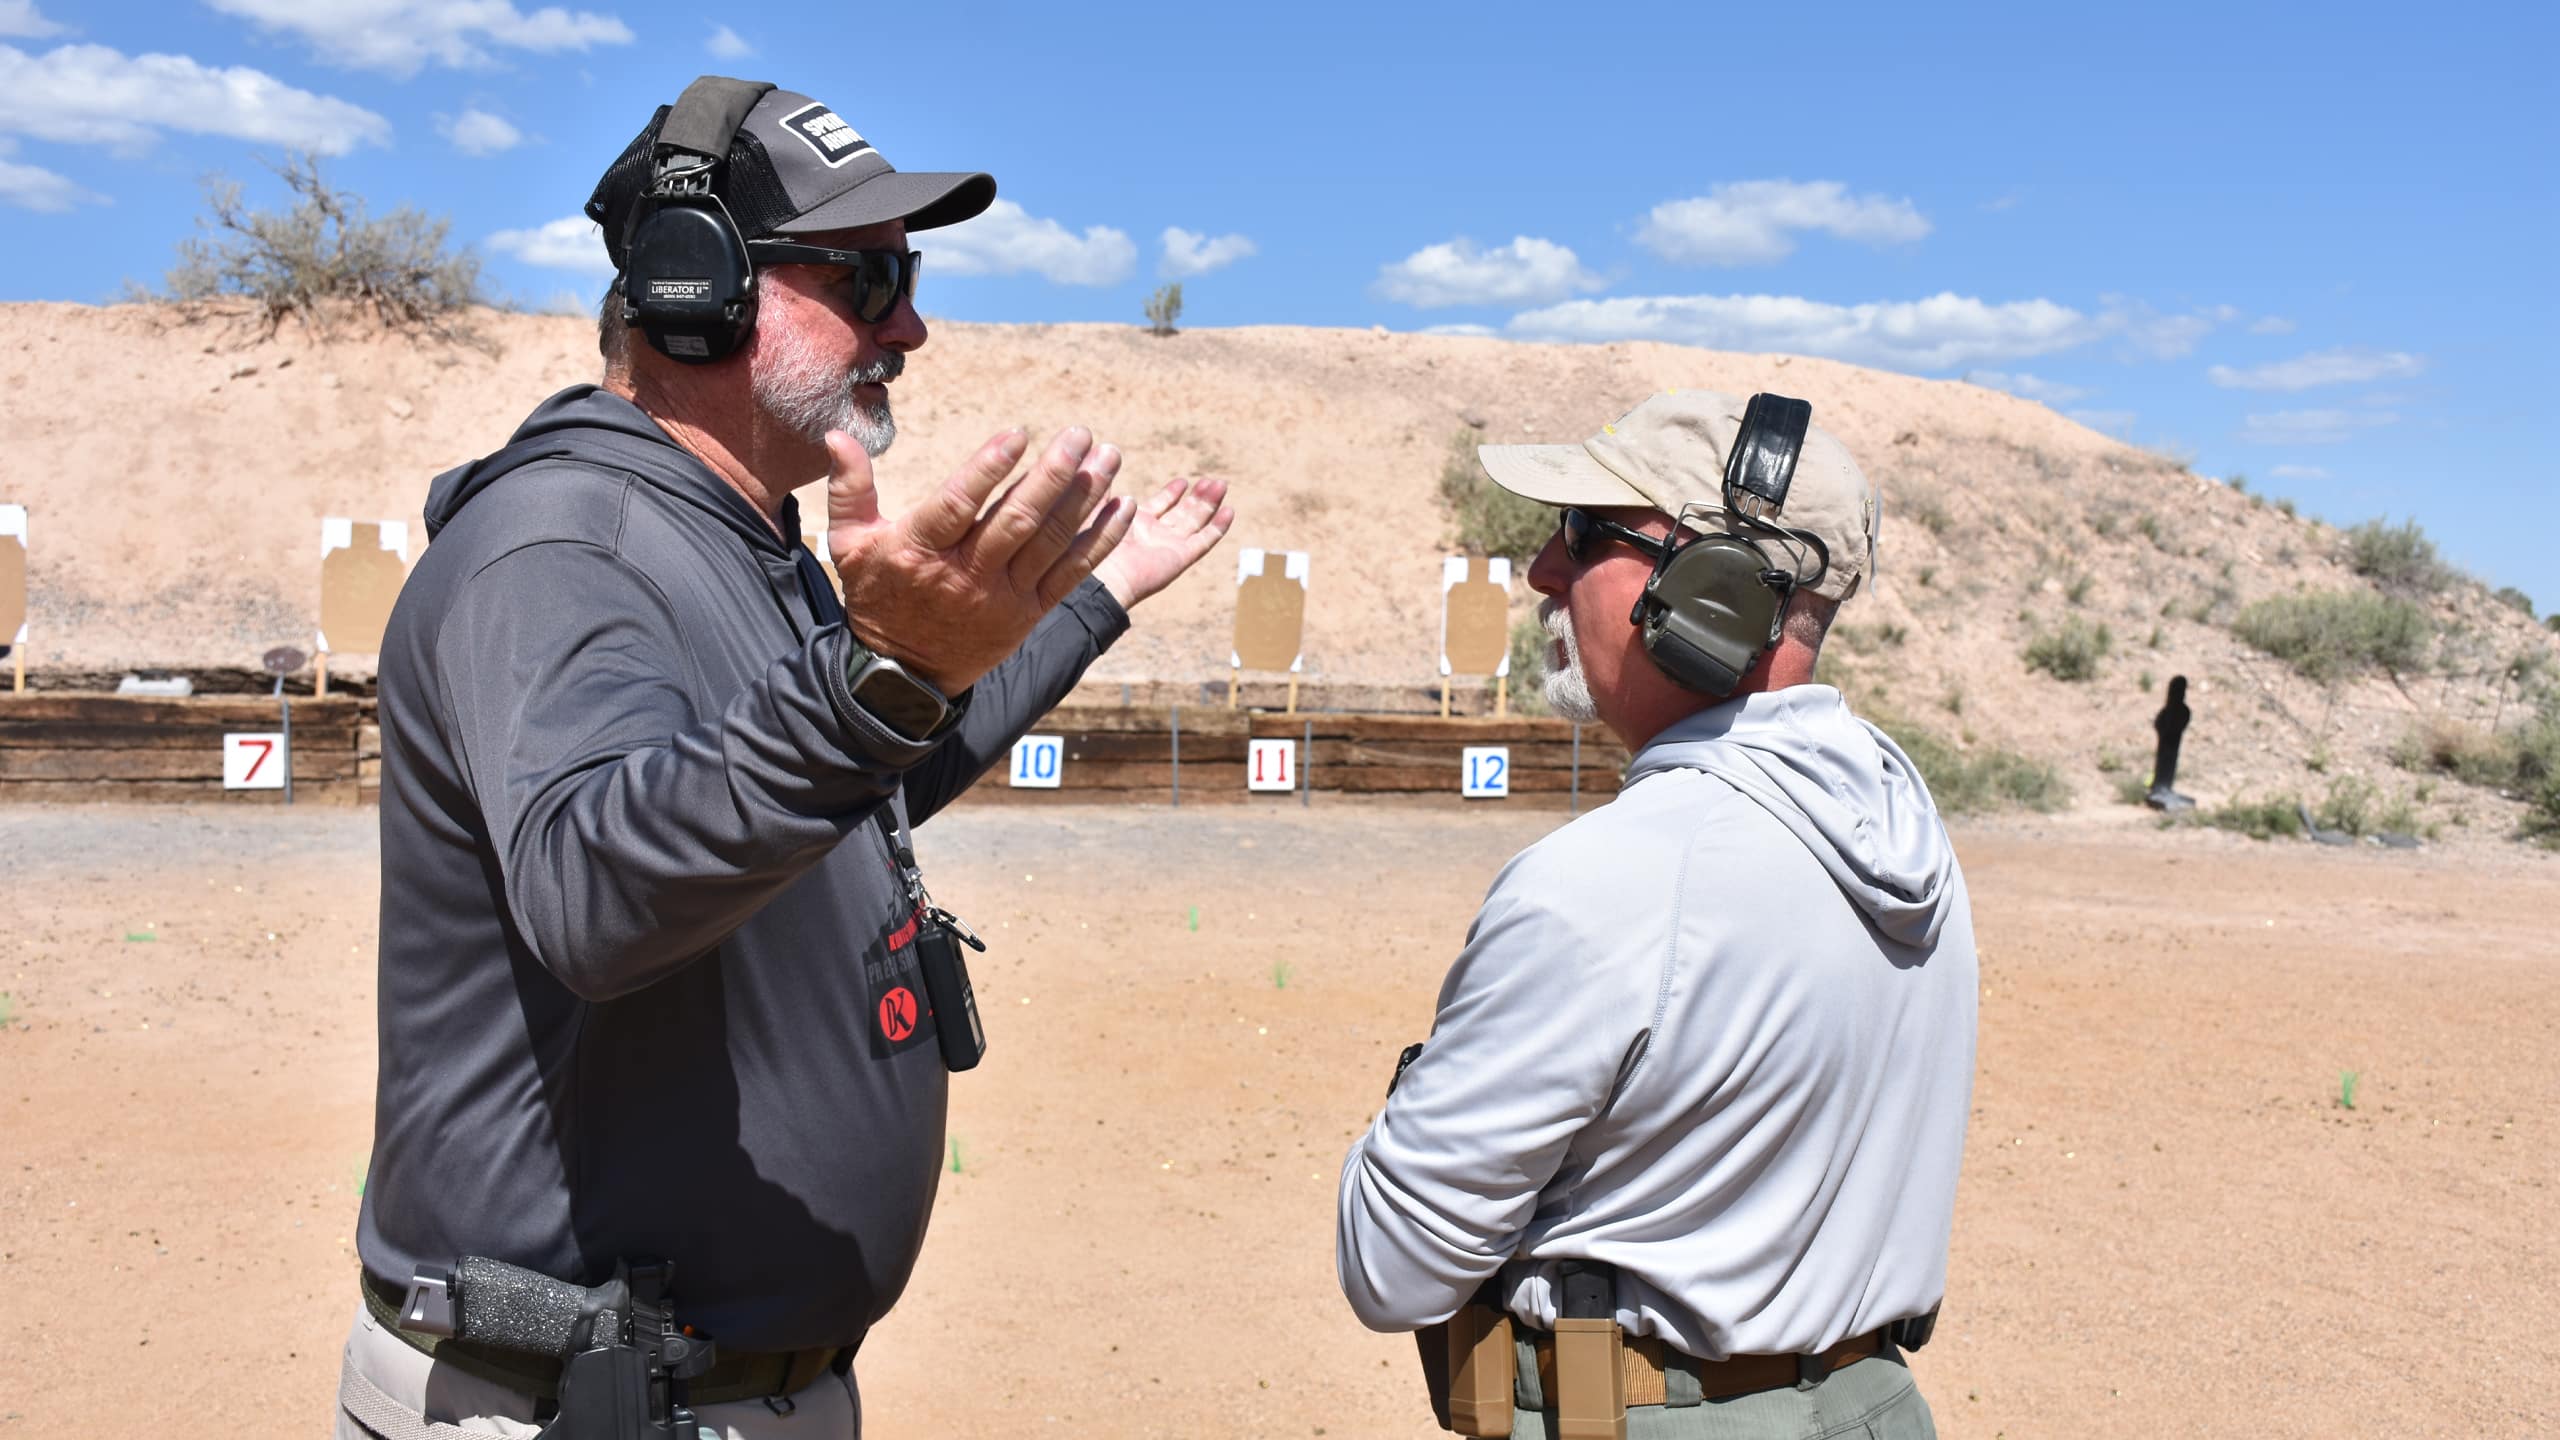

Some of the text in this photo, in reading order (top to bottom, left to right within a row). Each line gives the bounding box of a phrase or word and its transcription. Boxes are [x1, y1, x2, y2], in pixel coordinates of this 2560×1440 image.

[651, 285, 695, 294] LIBERATOR
[238, 740, 273, 782] 7
[1018, 743, 1056, 779] 10
[1255, 747, 1287, 782] 11
[1470, 755, 1504, 789] 12
